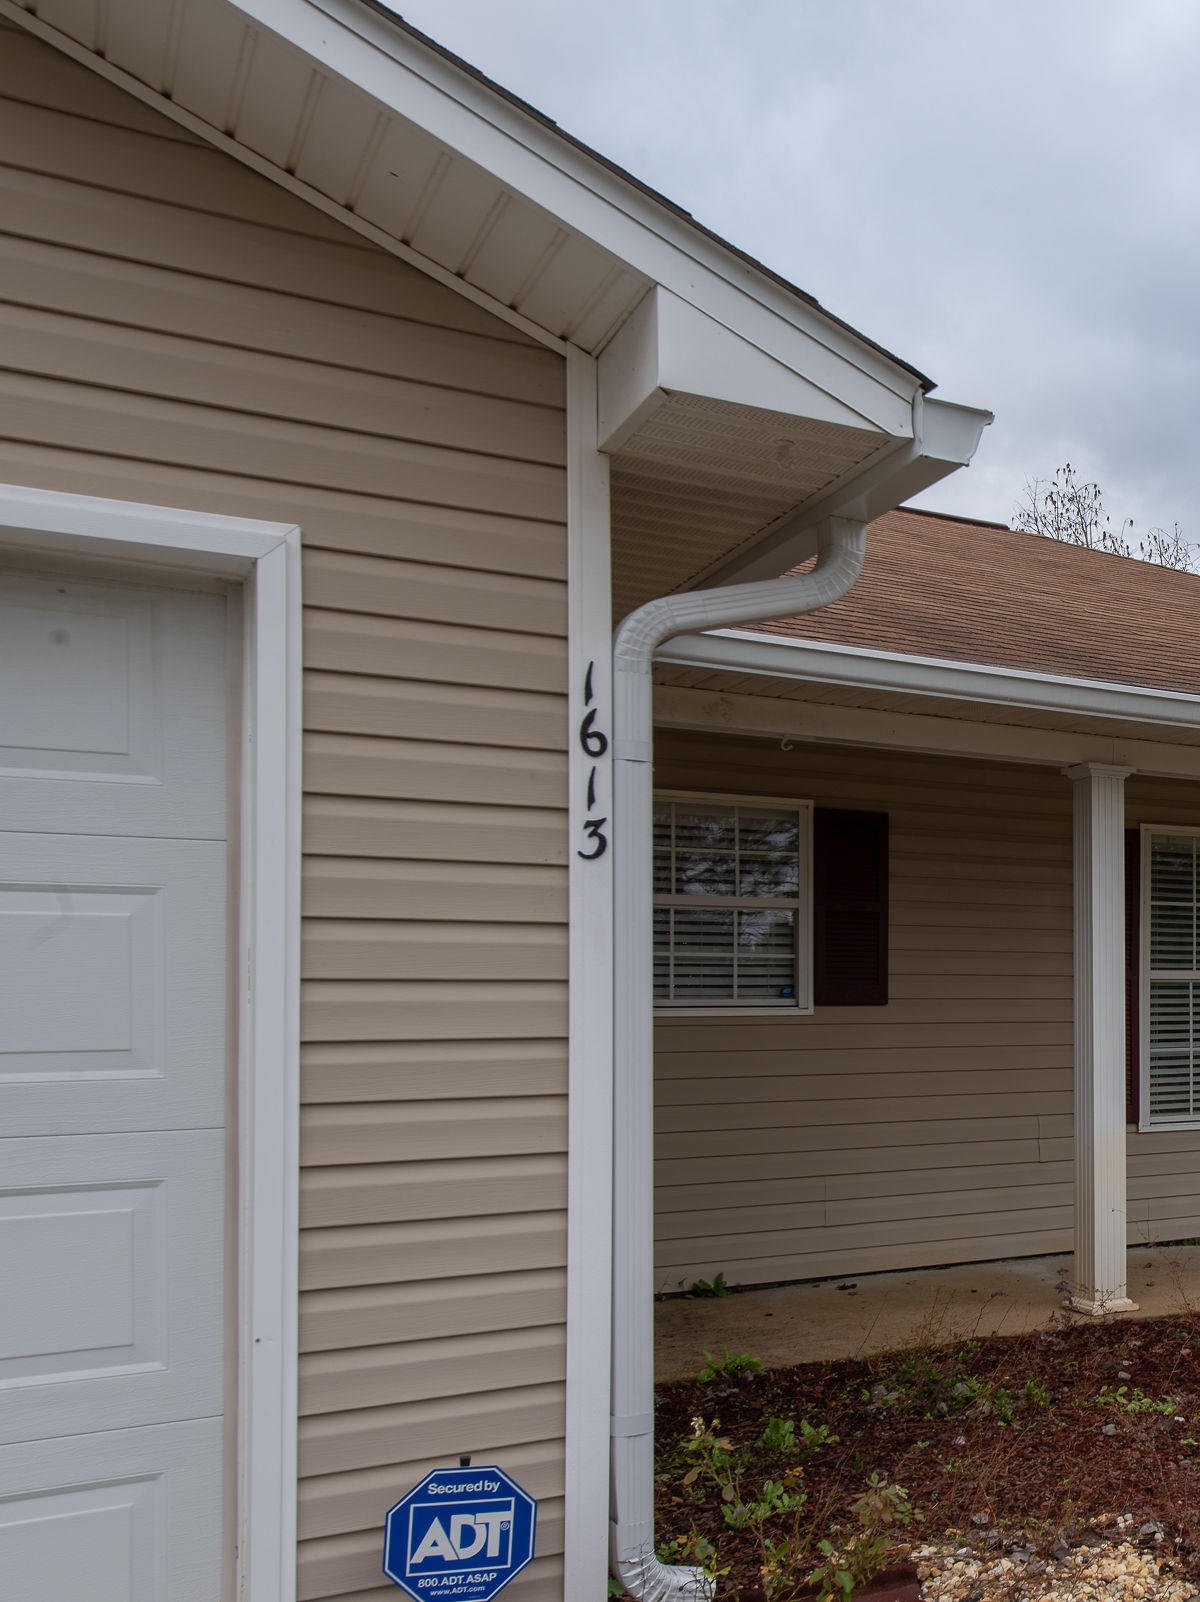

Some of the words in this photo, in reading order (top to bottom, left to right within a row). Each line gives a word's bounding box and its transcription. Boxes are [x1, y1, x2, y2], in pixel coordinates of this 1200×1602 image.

[577, 660, 608, 860] 1613
[427, 1480, 482, 1495] Secured
[483, 1479, 500, 1493] by
[410, 1511, 512, 1564] ADT
[417, 1572, 497, 1588] 800.ADT.ASAP
[430, 1586, 485, 1596] www.ADT.com
